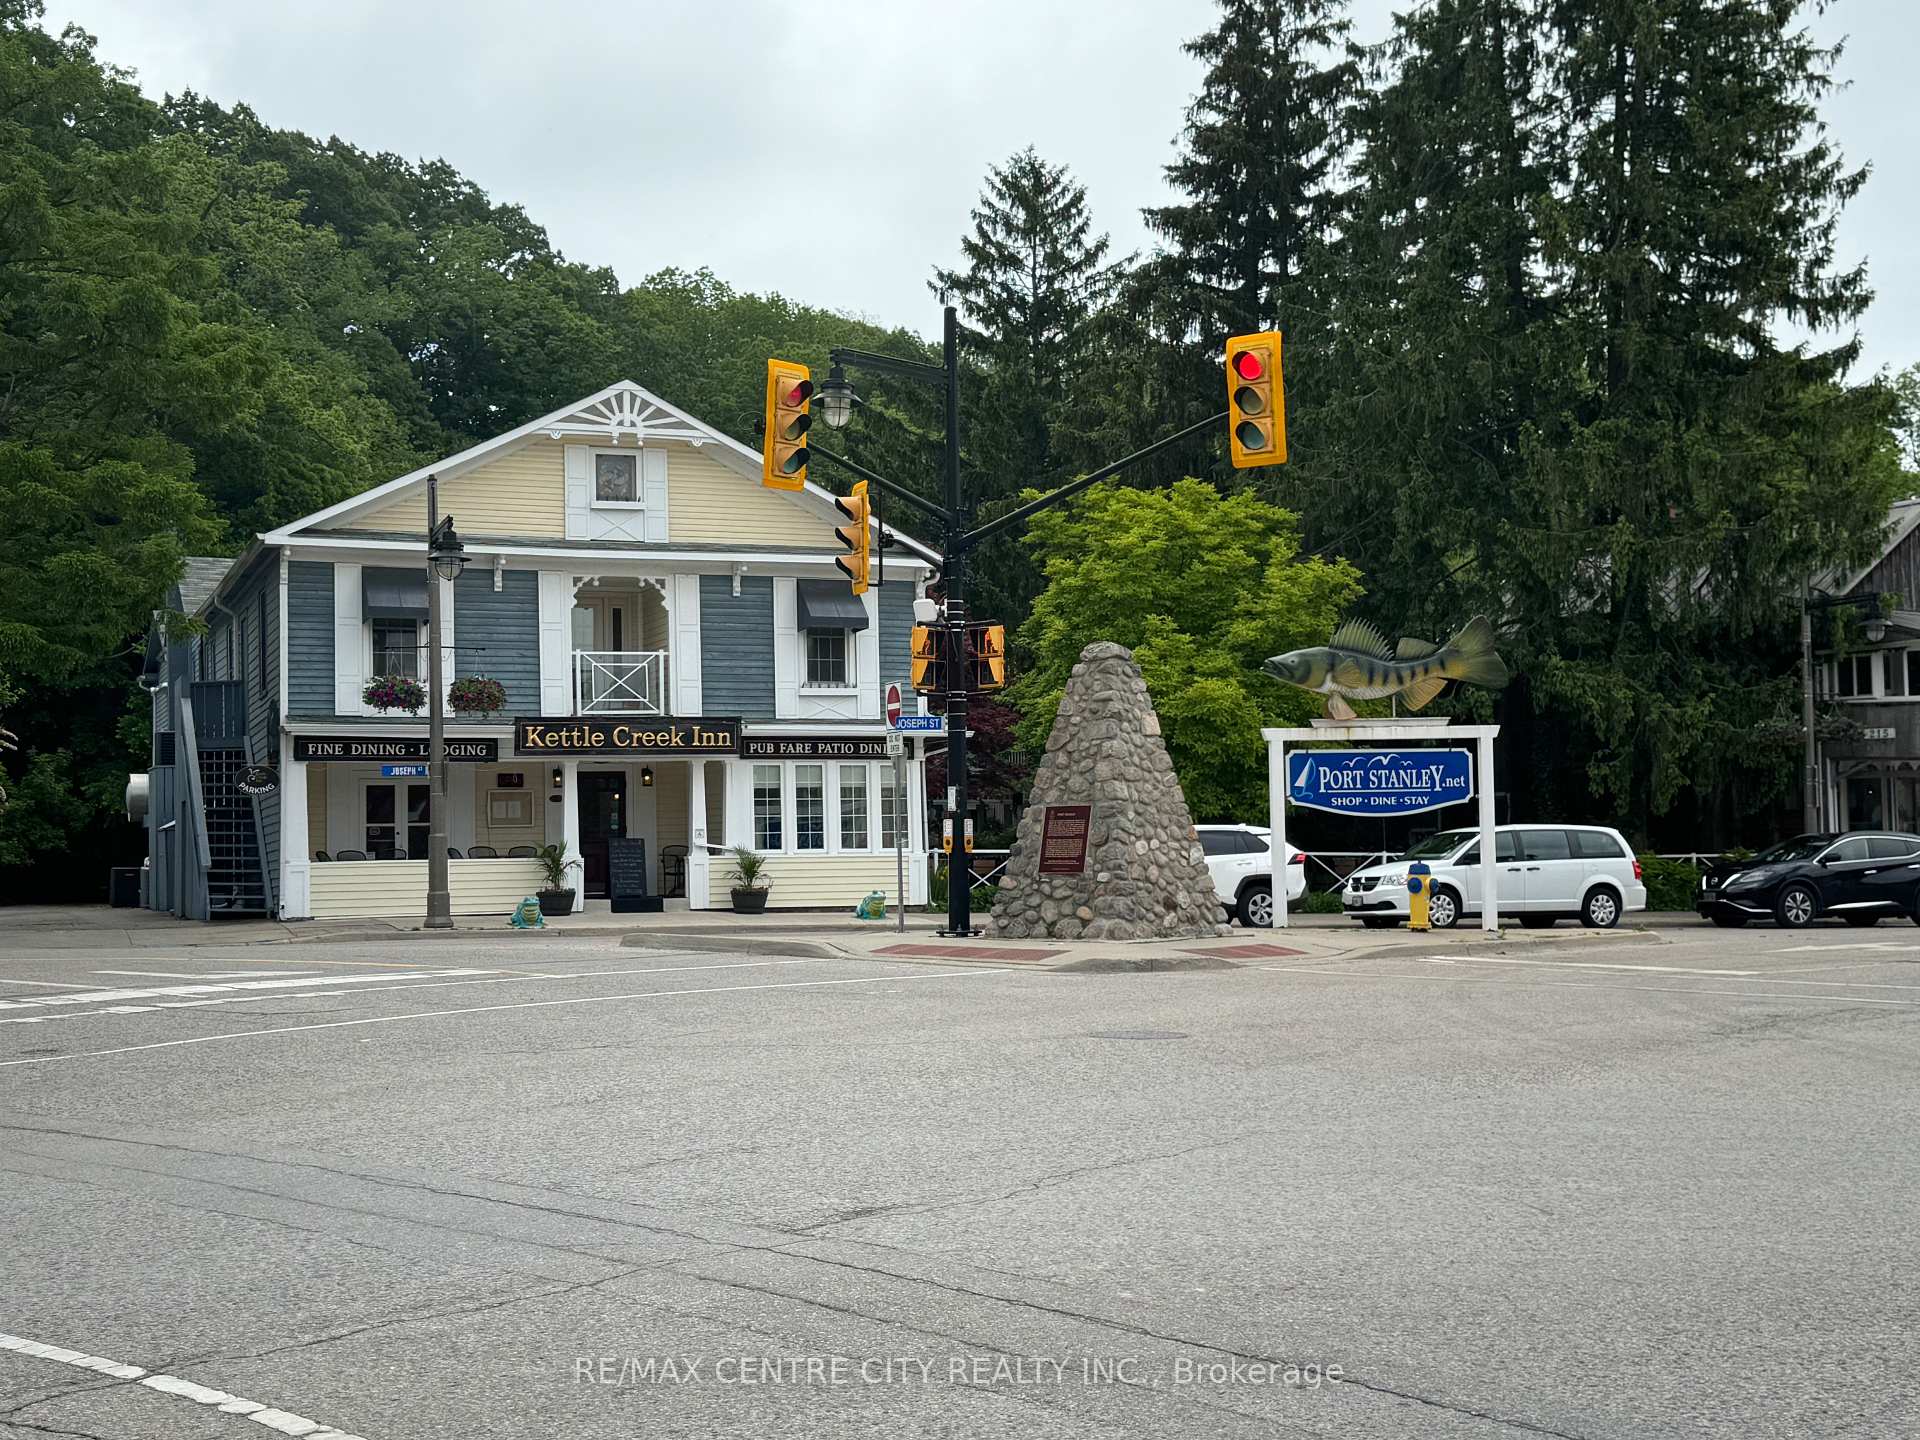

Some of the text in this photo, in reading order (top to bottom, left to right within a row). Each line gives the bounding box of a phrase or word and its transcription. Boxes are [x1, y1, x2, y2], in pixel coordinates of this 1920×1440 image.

[896, 718, 940, 729] JOSEPH ST
[525, 725, 732, 747] Kettle Creek Inn
[307, 743, 487, 756] FINE DINING LDGING
[749, 743, 774, 754] PUB
[779, 743, 813, 754] FARE
[817, 743, 854, 754] PATIO
[390, 766, 416, 776] JOSEPH
[1318, 766, 1364, 793] PORT
[238, 781, 276, 795] PARKING
[1331, 796, 1430, 806] SHOP DINE STAY
